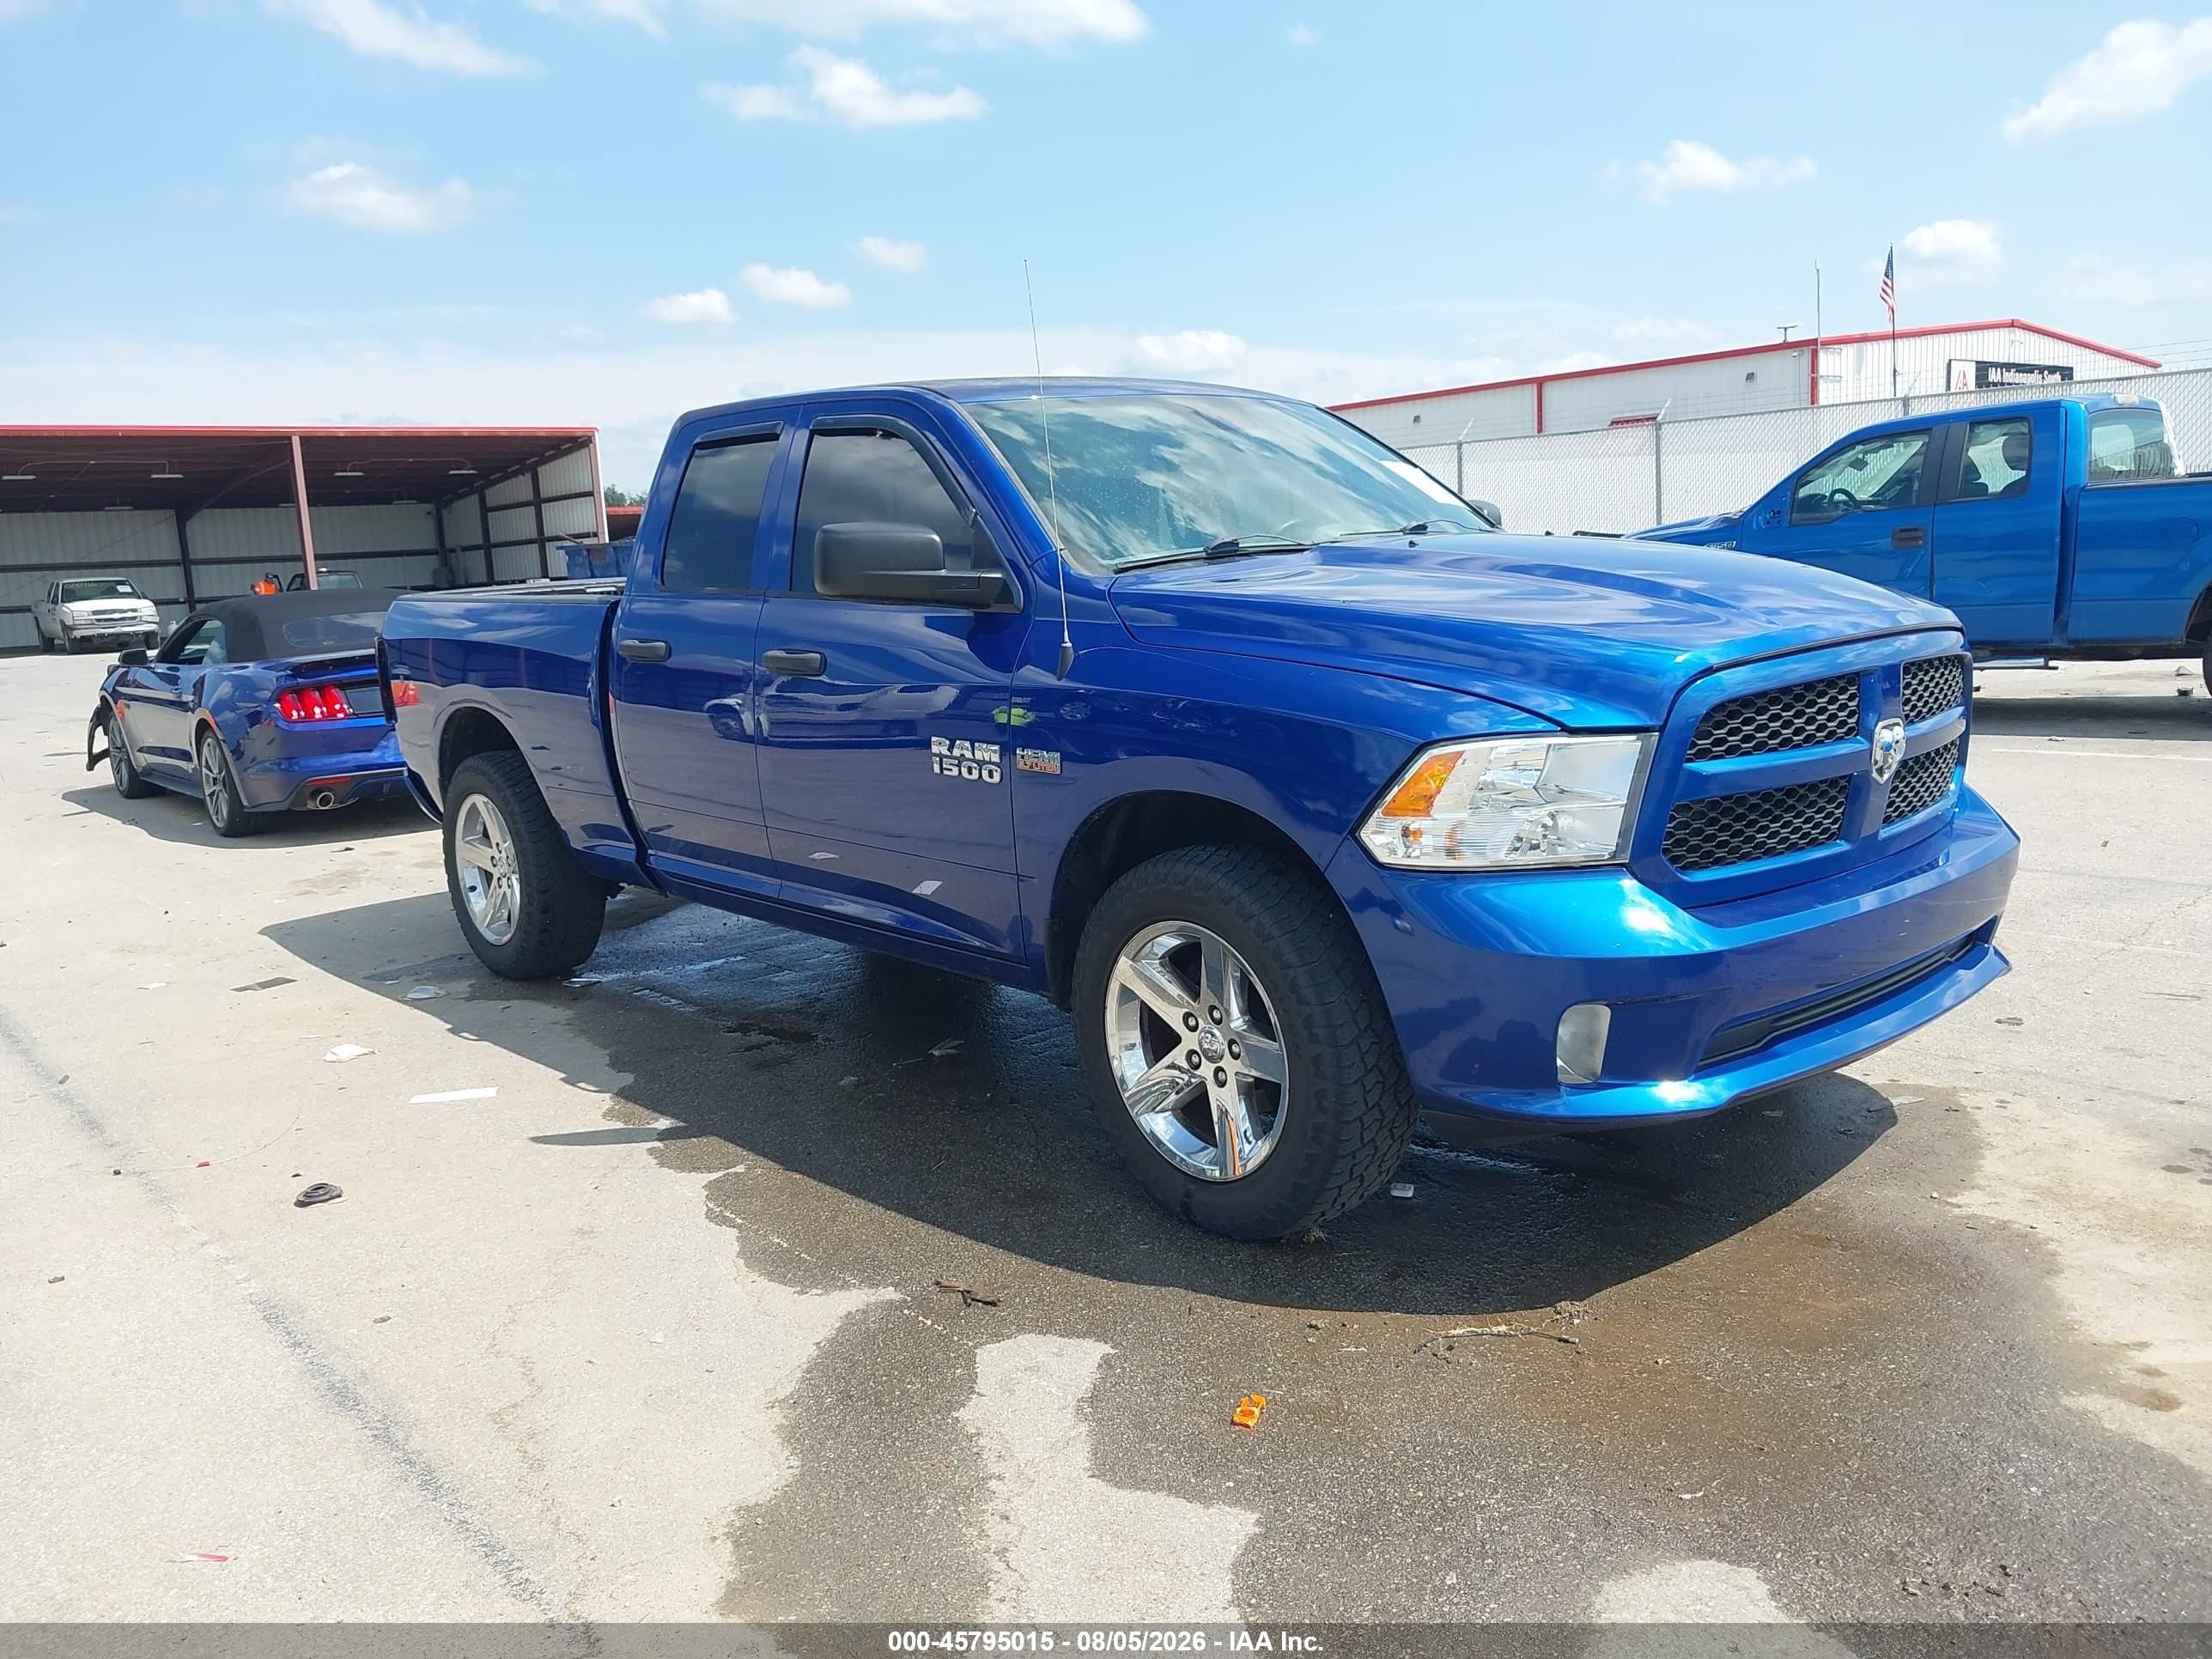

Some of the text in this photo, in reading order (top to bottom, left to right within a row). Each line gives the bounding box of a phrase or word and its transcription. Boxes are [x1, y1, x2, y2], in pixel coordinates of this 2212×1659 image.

[1988, 367, 2002, 383] IAA
[2002, 368, 2042, 385] Indianapolis
[2043, 369, 2062, 384] South
[931, 736, 1002, 763] RAM
[1017, 747, 1060, 764] HEMI
[932, 757, 1003, 784] 1500
